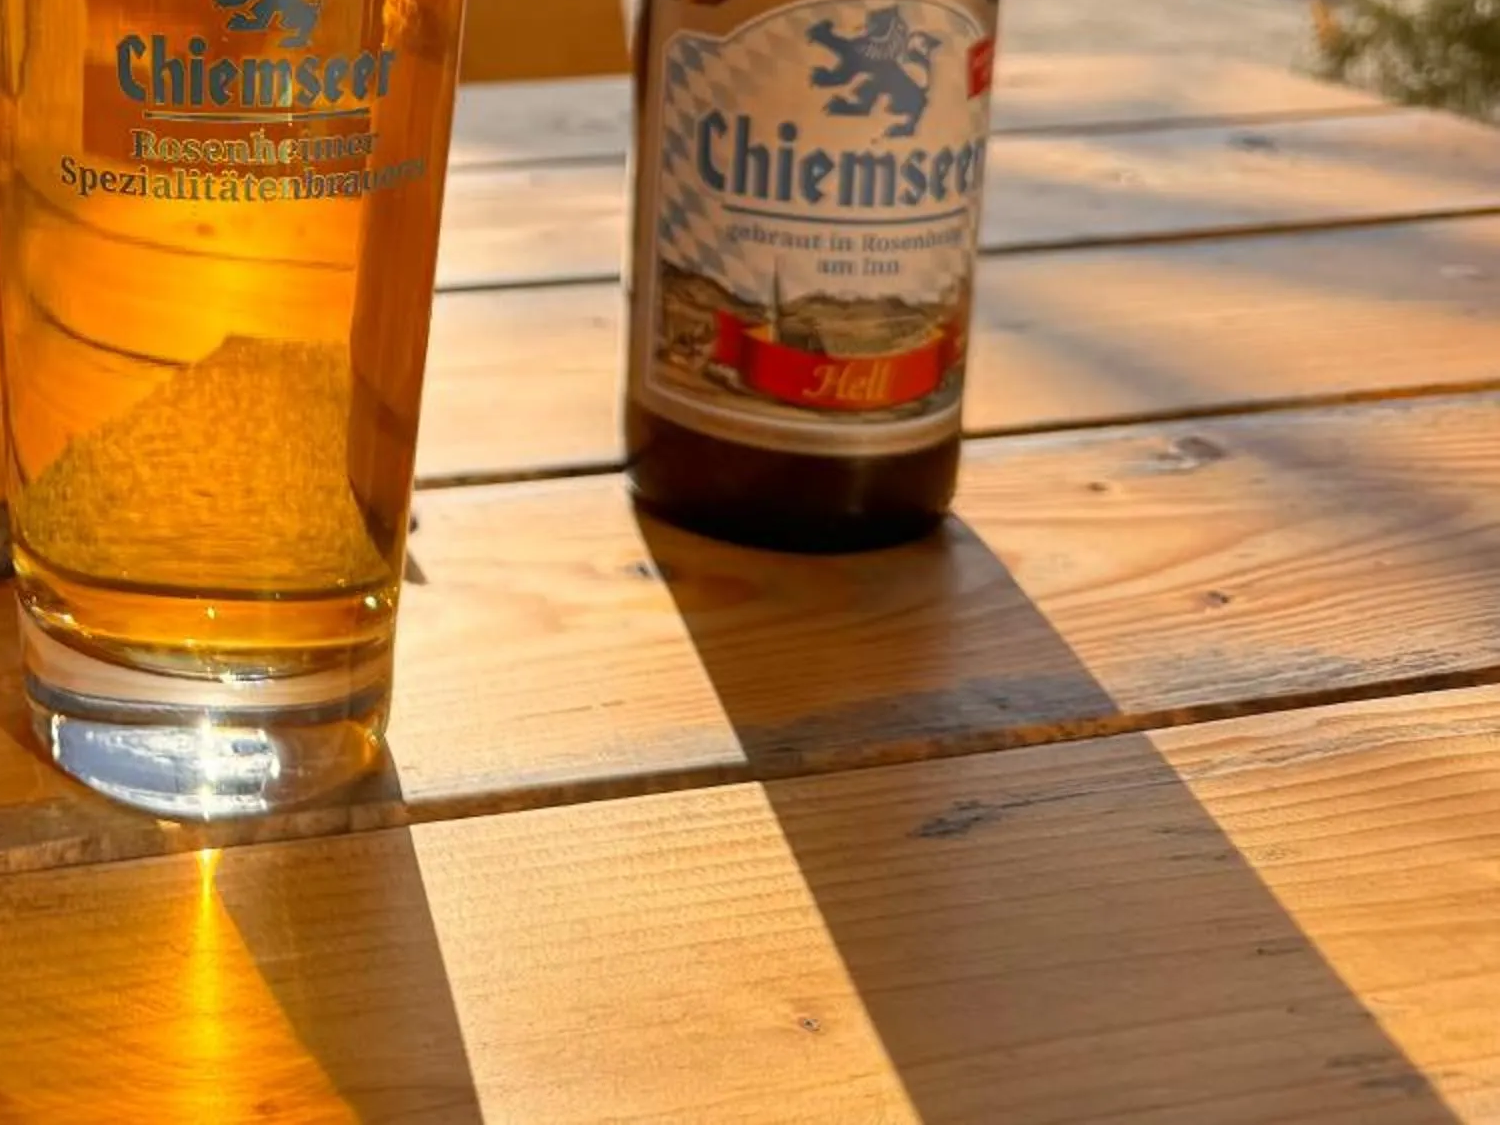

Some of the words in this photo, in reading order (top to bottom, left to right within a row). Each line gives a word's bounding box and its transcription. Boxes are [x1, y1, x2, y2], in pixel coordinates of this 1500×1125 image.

[115, 34, 397, 109] Chiemseer
[130, 127, 380, 165] Rosenheimer
[726, 224, 820, 250] gebraut
[829, 229, 854, 252] in
[802, 360, 891, 401] Hell
